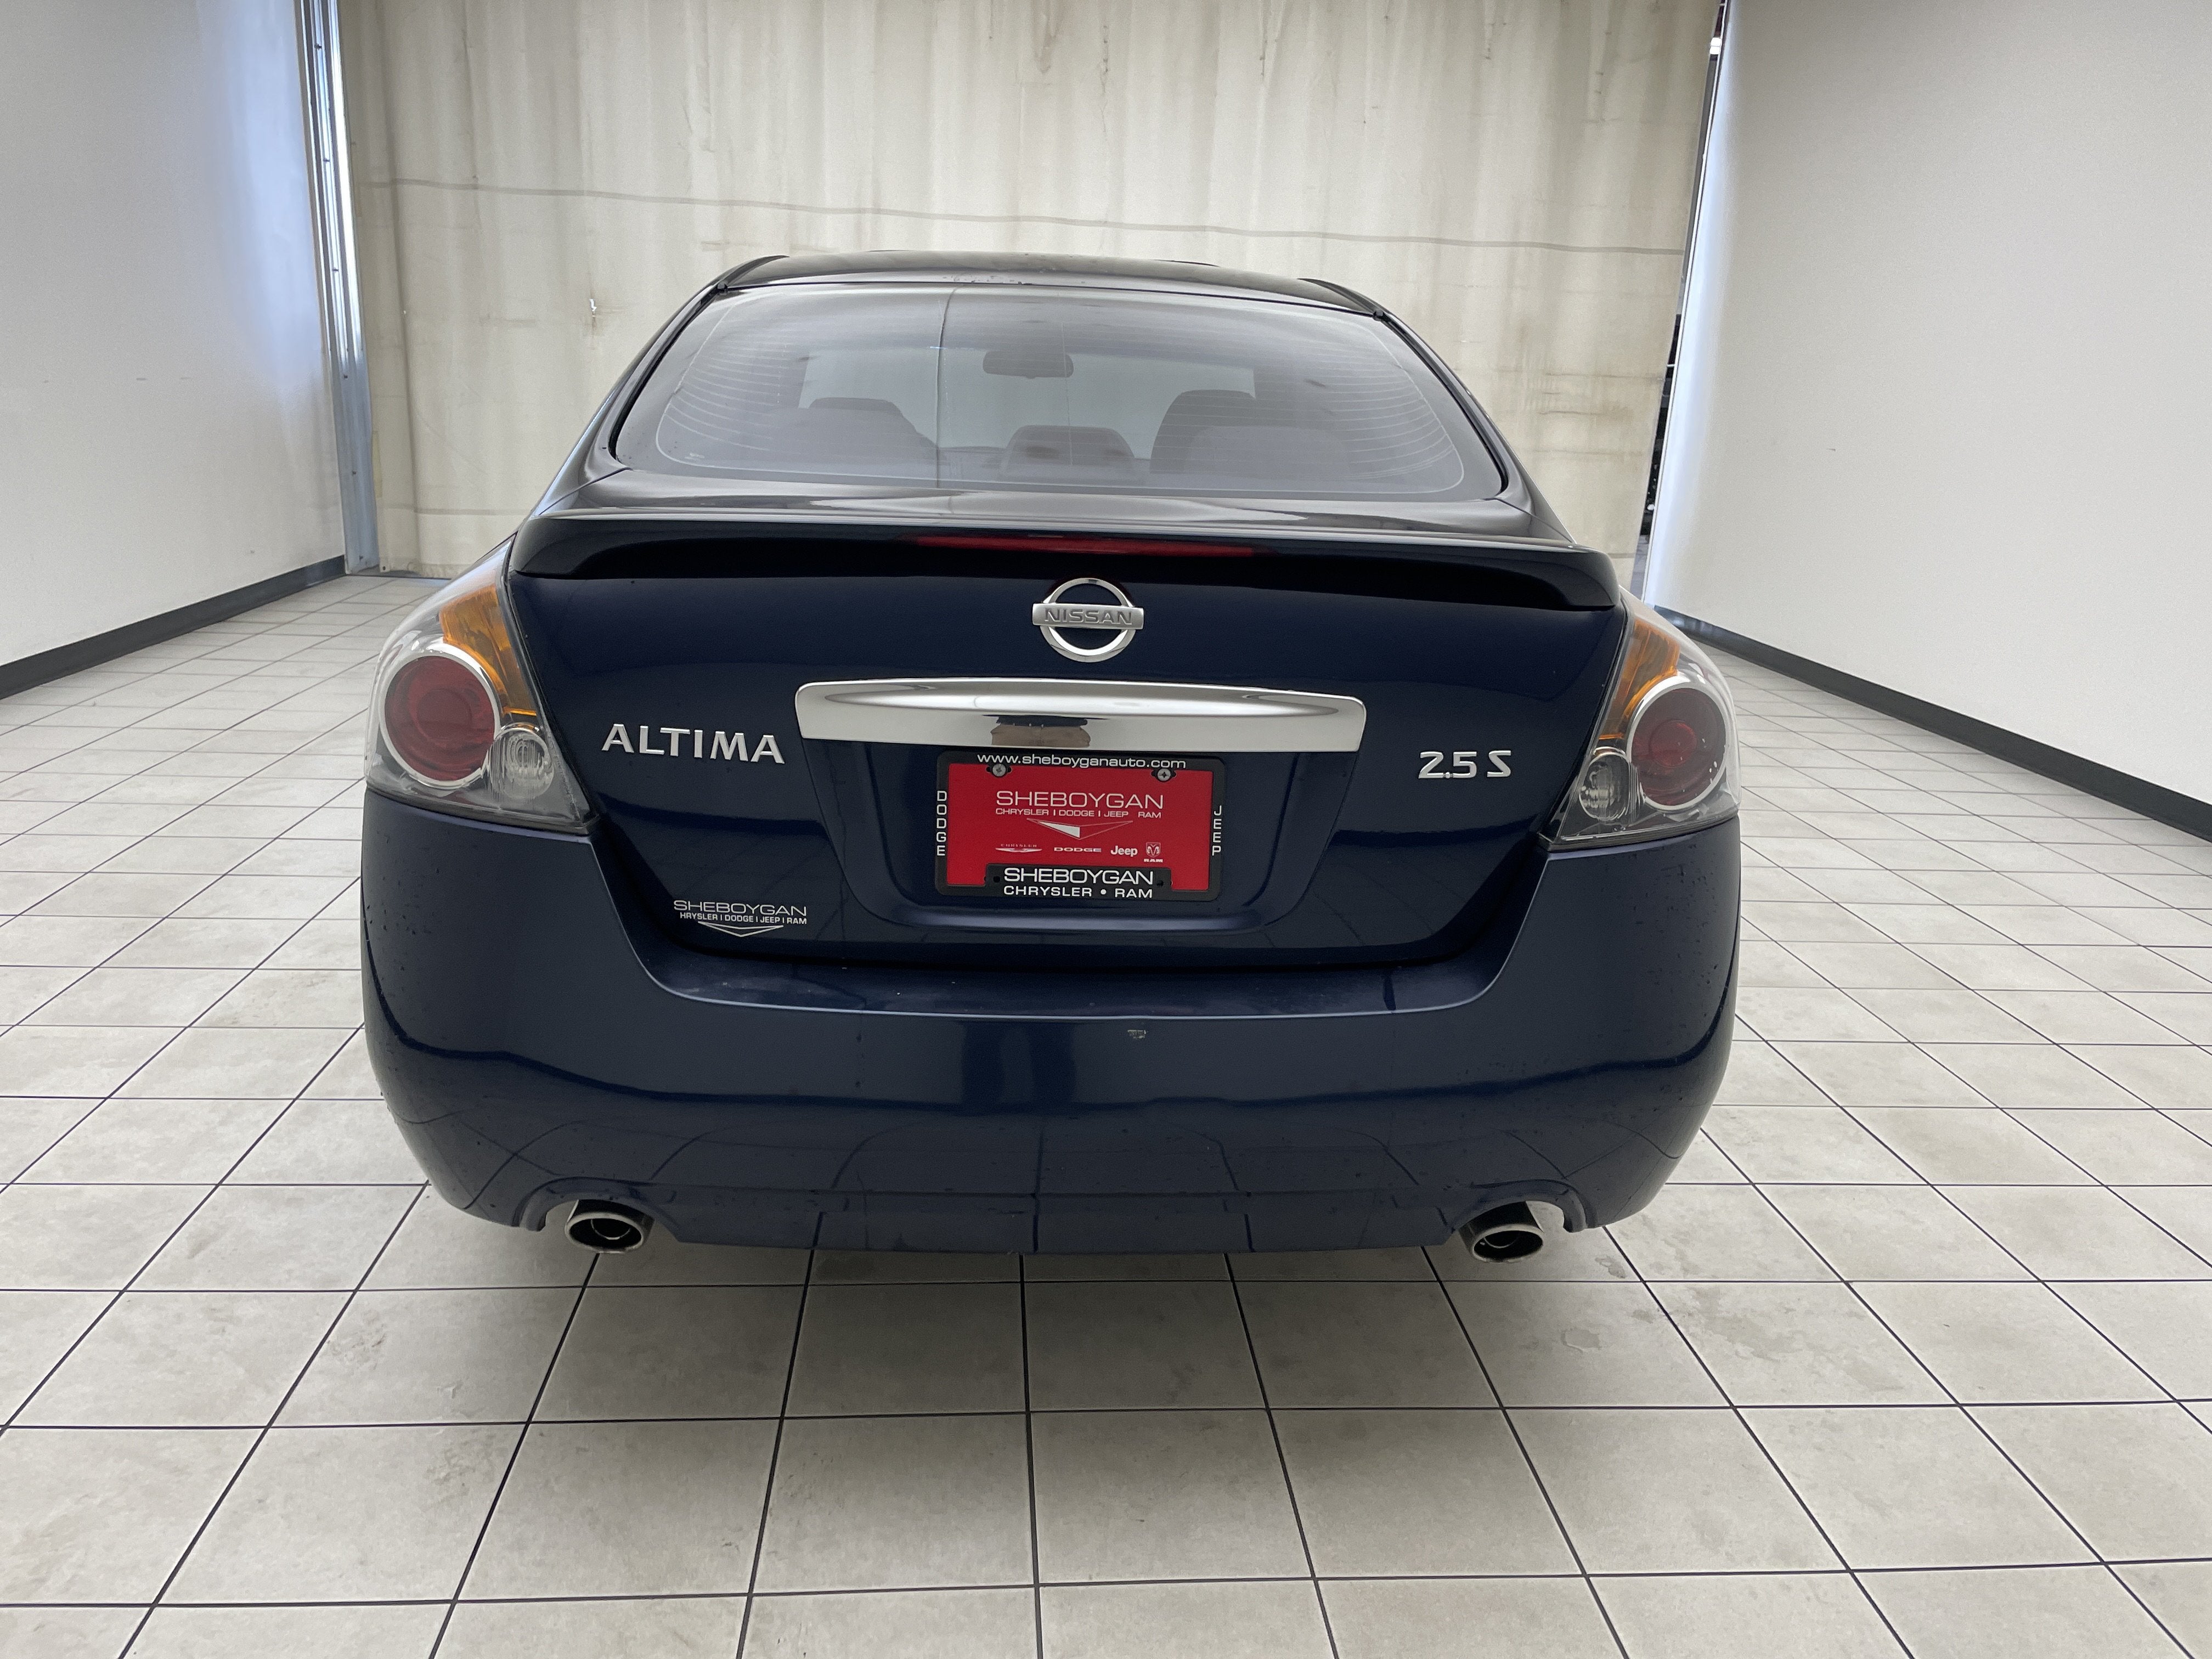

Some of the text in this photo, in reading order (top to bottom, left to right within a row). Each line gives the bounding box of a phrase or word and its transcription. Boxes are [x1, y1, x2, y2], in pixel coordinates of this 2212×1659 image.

[1045, 608, 1132, 625] NISSAN
[602, 723, 785, 764] ALTIMA
[977, 754, 1186, 769] www.sheboyganauto.com
[1418, 750, 1511, 779] 2.5 S
[996, 791, 1164, 809] SHEBOYGAN
[995, 808, 1049, 816] CHRYSLER
[936, 790, 948, 857] DODGE
[1211, 805, 1222, 856] JEEP
[1110, 845, 1138, 857] Jeep
[1004, 867, 1154, 885] SHEBOYGAN
[1003, 885, 1153, 898] CHRYSLER RAM
[674, 900, 808, 917] SHEBOYGAN
[724, 914, 754, 923] DODGE
[760, 916, 781, 924] JEEP
[786, 917, 808, 925] RAM
